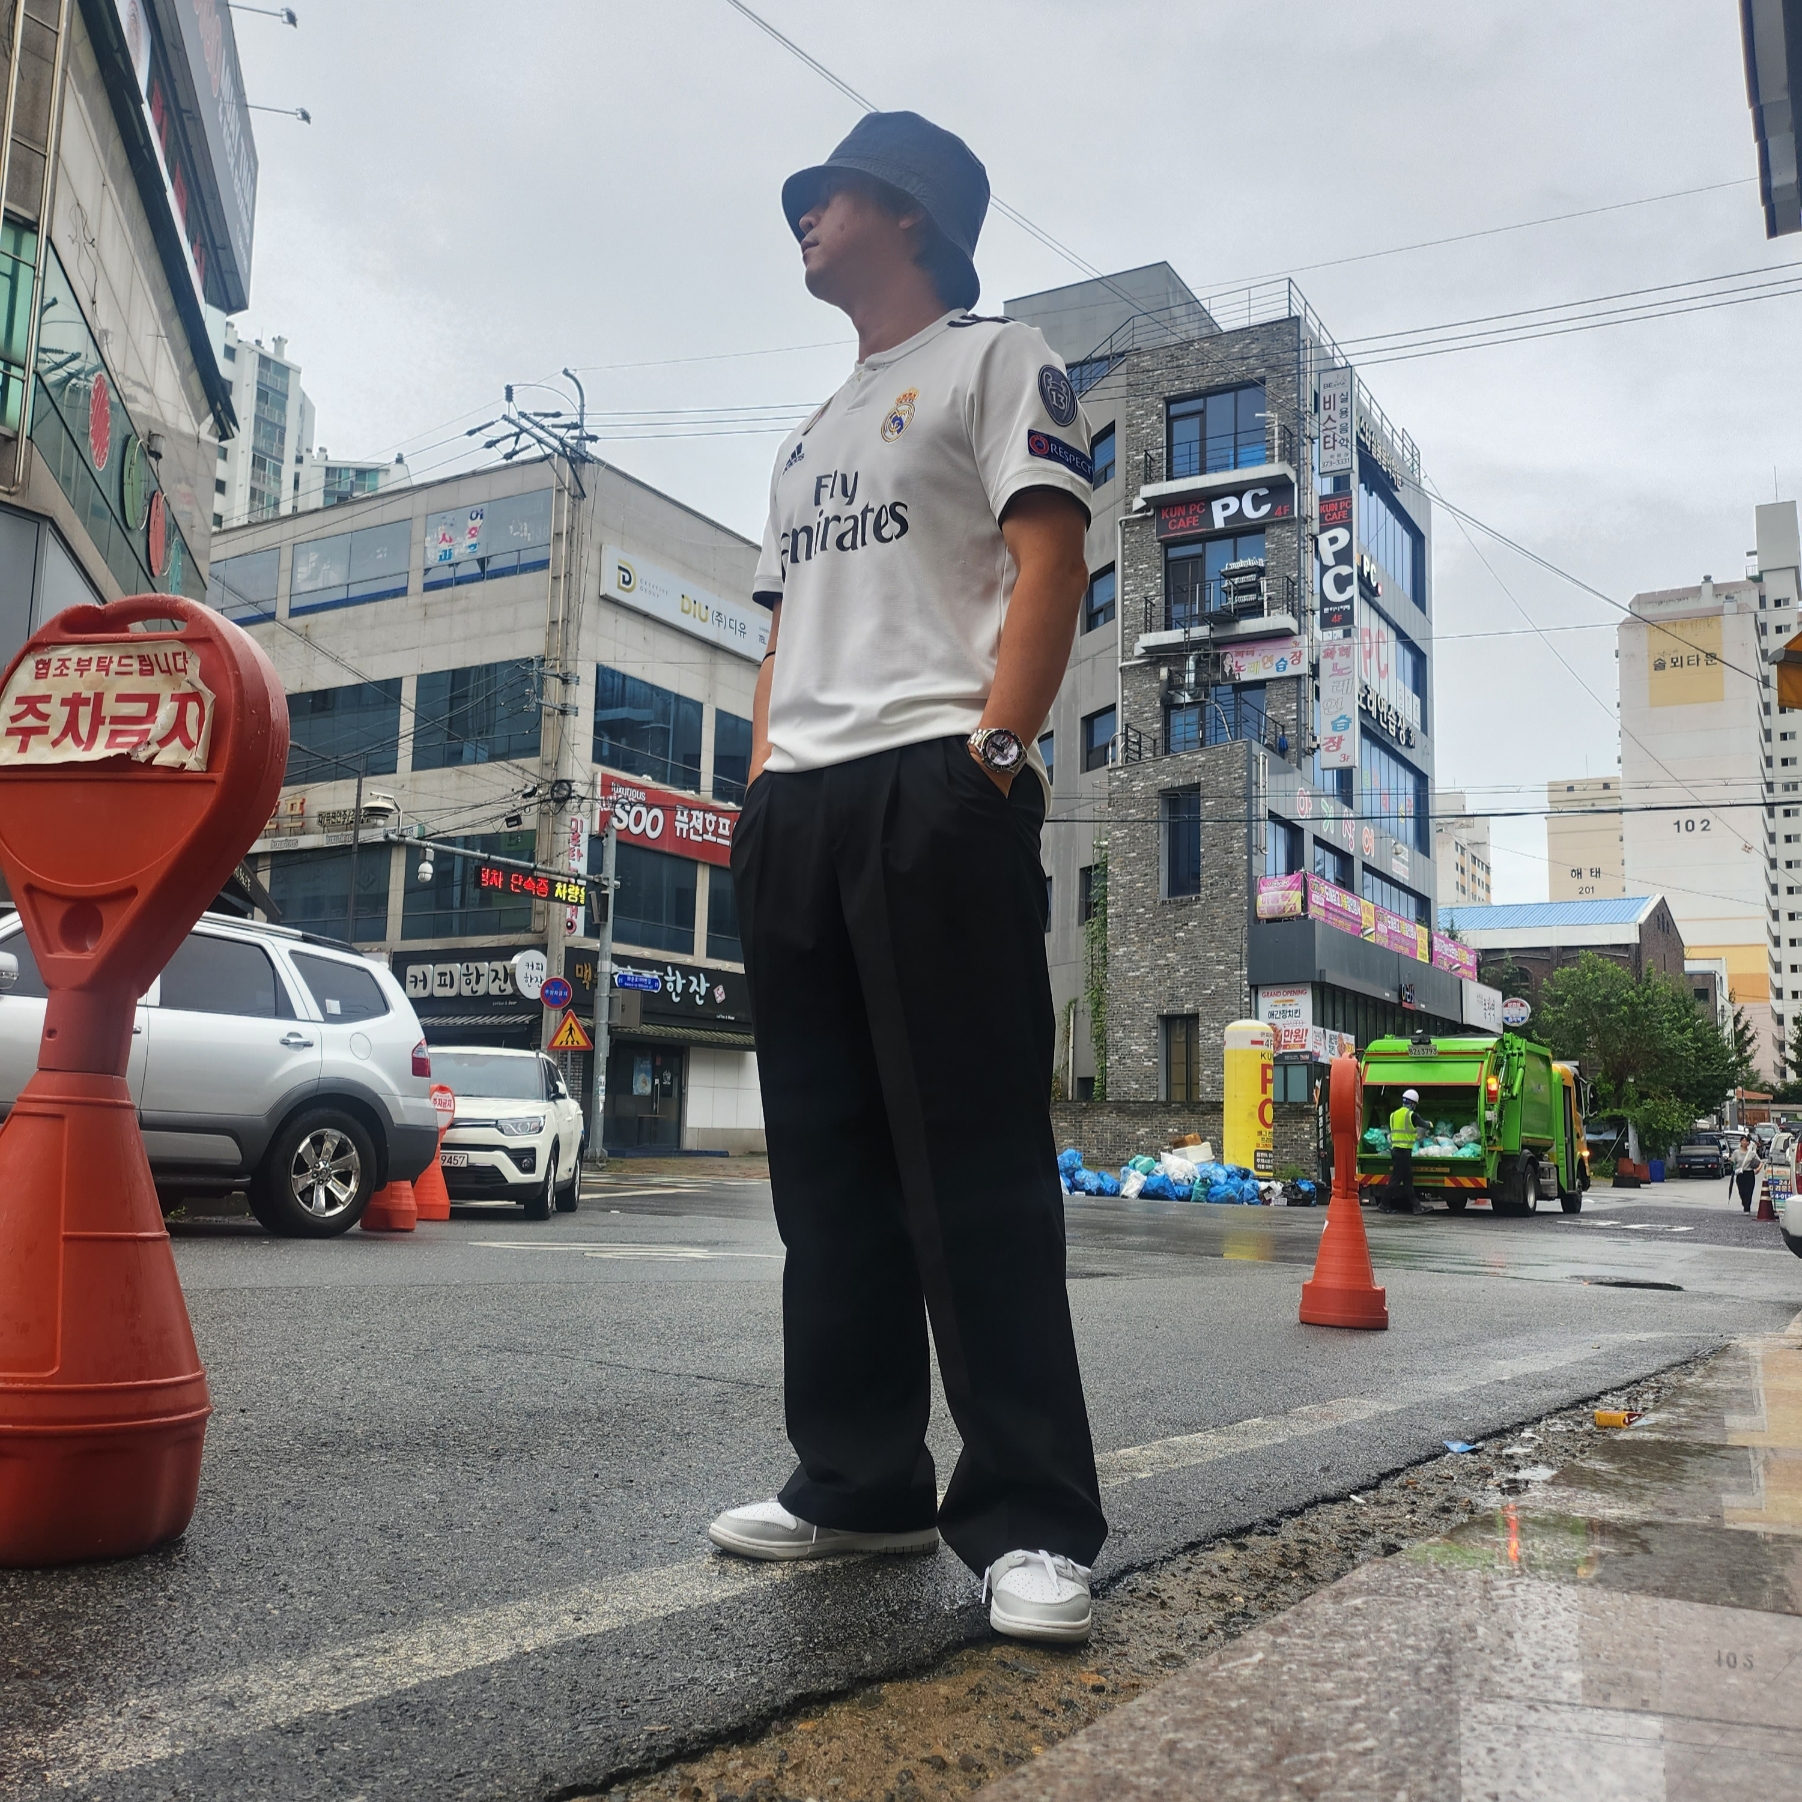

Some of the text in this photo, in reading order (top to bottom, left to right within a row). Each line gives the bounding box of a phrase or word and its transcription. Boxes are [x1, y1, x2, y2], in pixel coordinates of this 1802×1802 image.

[1052, 391, 1065, 410] 13
[1322, 393, 1337, 451] 비스타
[1050, 443, 1092, 474] RESPECT
[814, 469, 859, 506] Fly
[1161, 502, 1206, 519] KUN PC
[1211, 487, 1272, 529] PC
[1274, 504, 1290, 517] 4F
[1320, 500, 1352, 513] KUN PC
[1168, 516, 1200, 530] CAFE
[1325, 511, 1348, 522] CAFE
[1317, 527, 1354, 603] PC
[1363, 554, 1377, 588] PC
[1331, 614, 1342, 623] 4F
[1361, 628, 1388, 679] PC
[1653, 653, 1718, 671] 솔뫼타운
[1339, 753, 1351, 762] 3F
[612, 797, 664, 839] SOO
[1673, 820, 1711, 833] 102
[1578, 886, 1595, 894] 201
[525, 962, 544, 971] 커피
[1262, 988, 1308, 998] GRAND OPENING
[1283, 1028, 1308, 1043] 만원!
[441, 1156, 465, 1165] 9457
